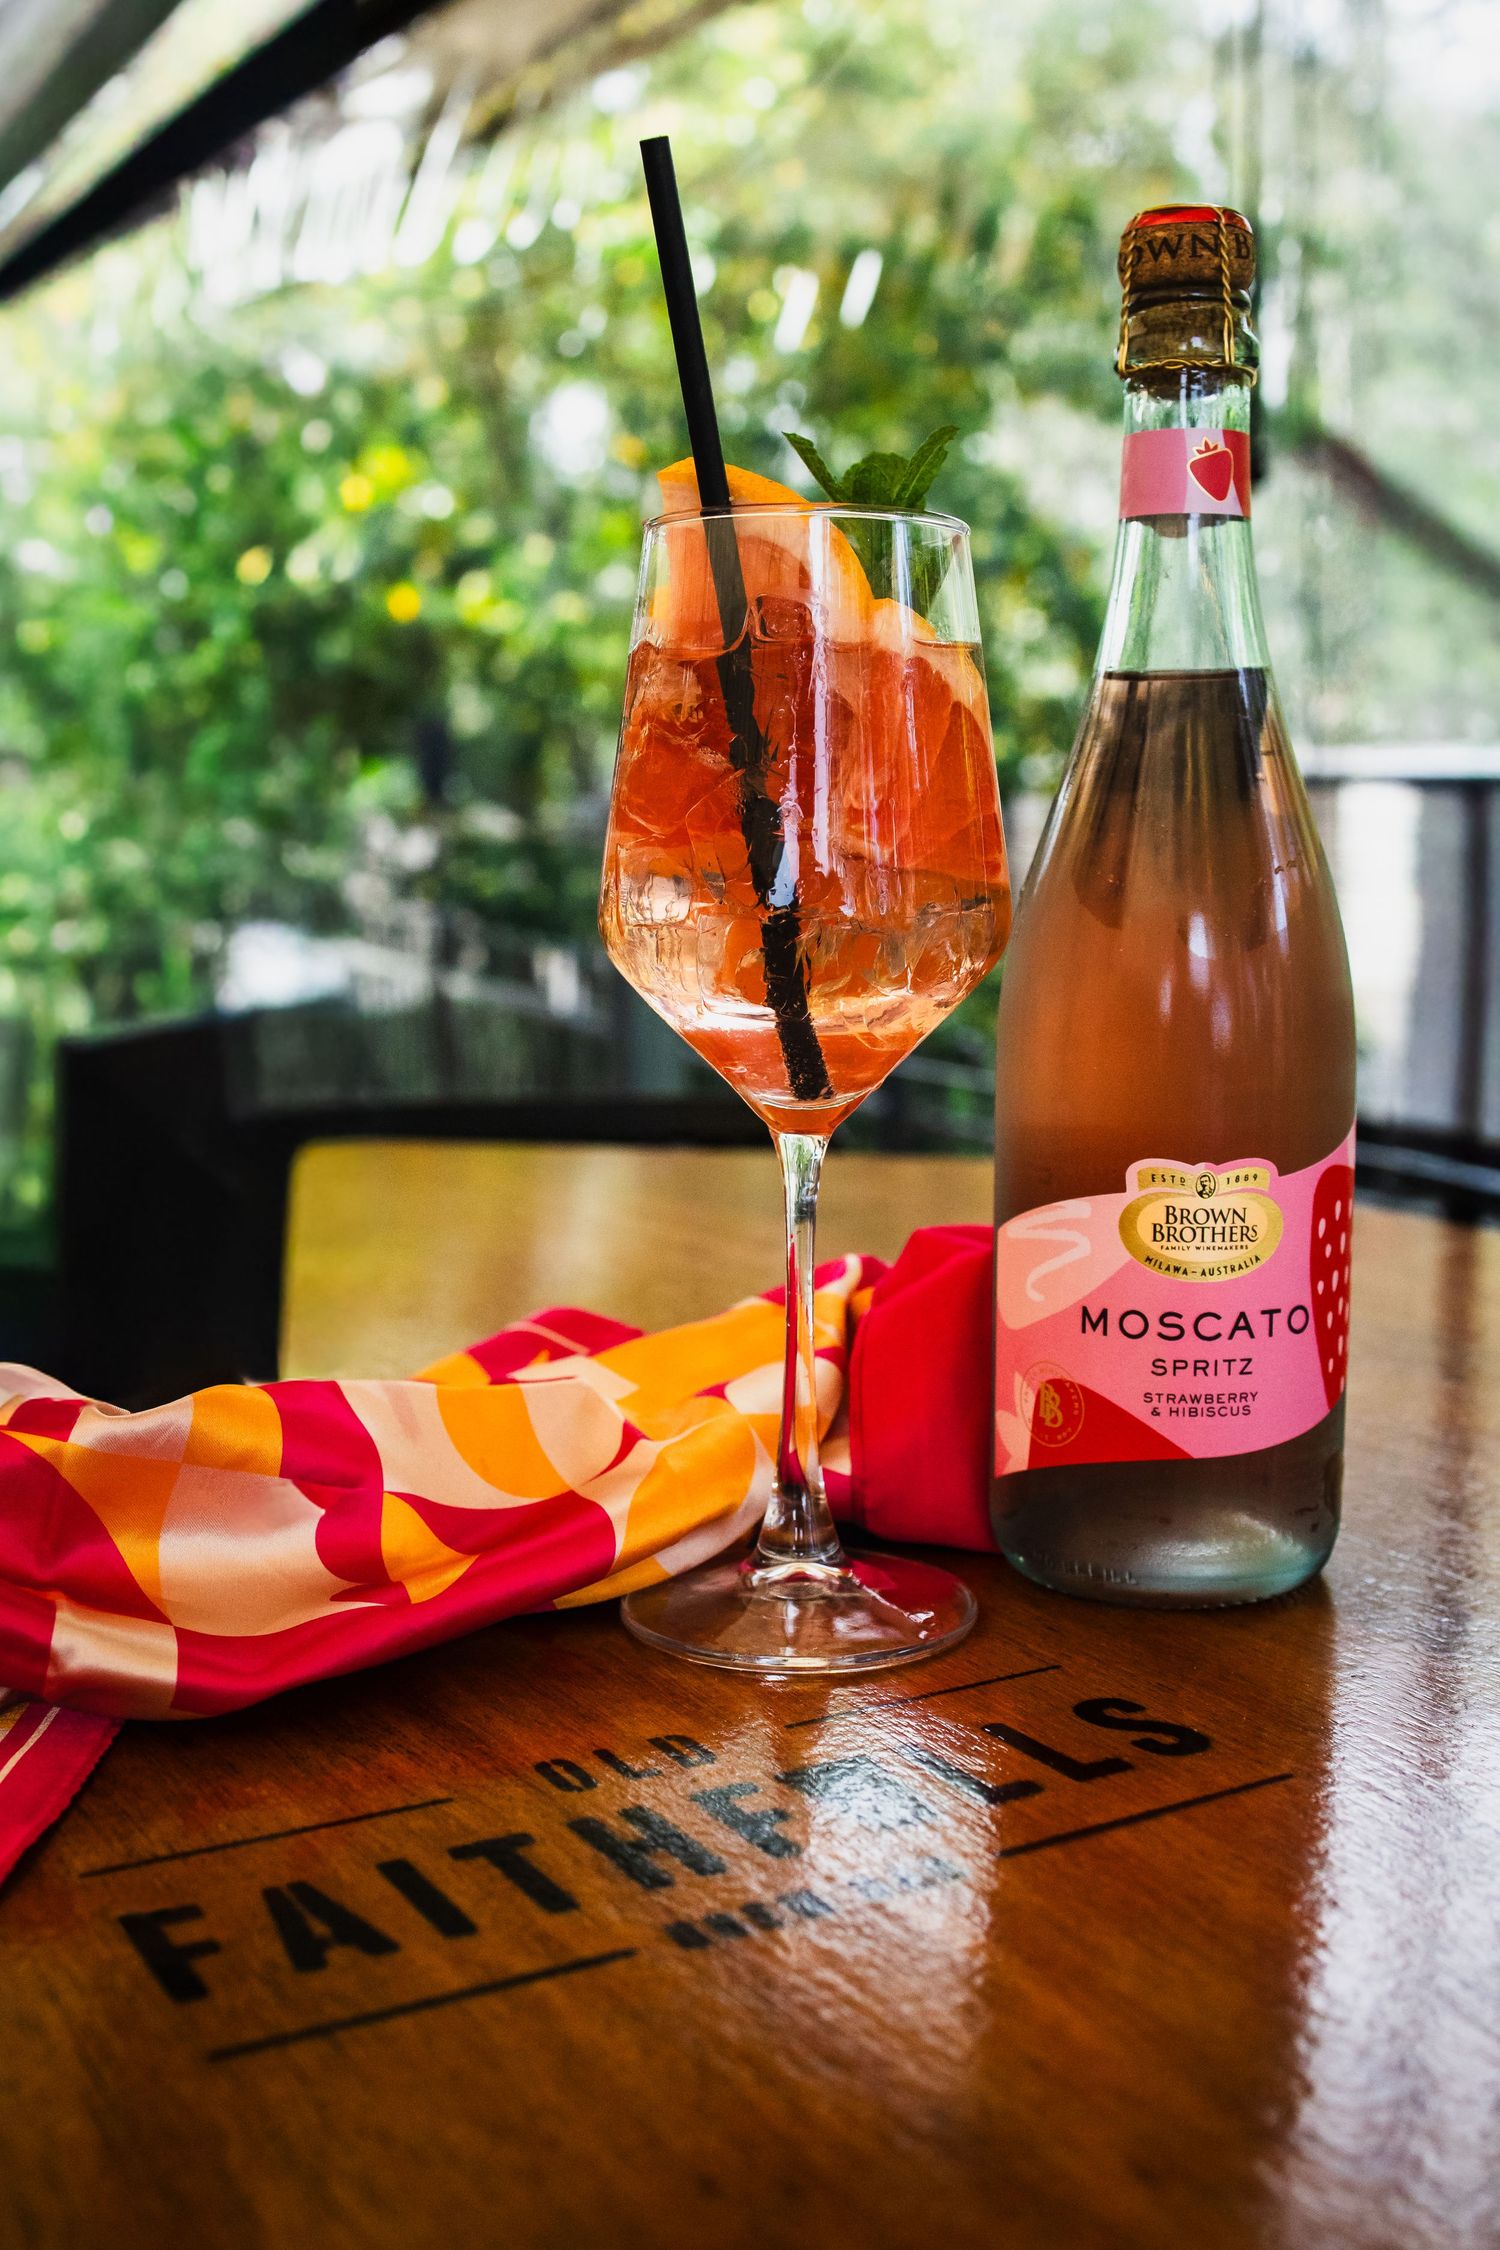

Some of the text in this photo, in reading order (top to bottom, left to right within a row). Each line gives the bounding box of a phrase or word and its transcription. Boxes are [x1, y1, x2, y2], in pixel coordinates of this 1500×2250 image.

[1164, 1205, 1247, 1225] BROWN
[1151, 1223, 1259, 1243] BROTHERS
[1081, 1305, 1309, 1341] MOSCATO
[1151, 1358, 1253, 1376] SPRITZ
[1143, 1391, 1258, 1404] STRAWBERRY
[1151, 1405, 1251, 1417] & HIBISCUS
[533, 1734, 716, 1792] OLD
